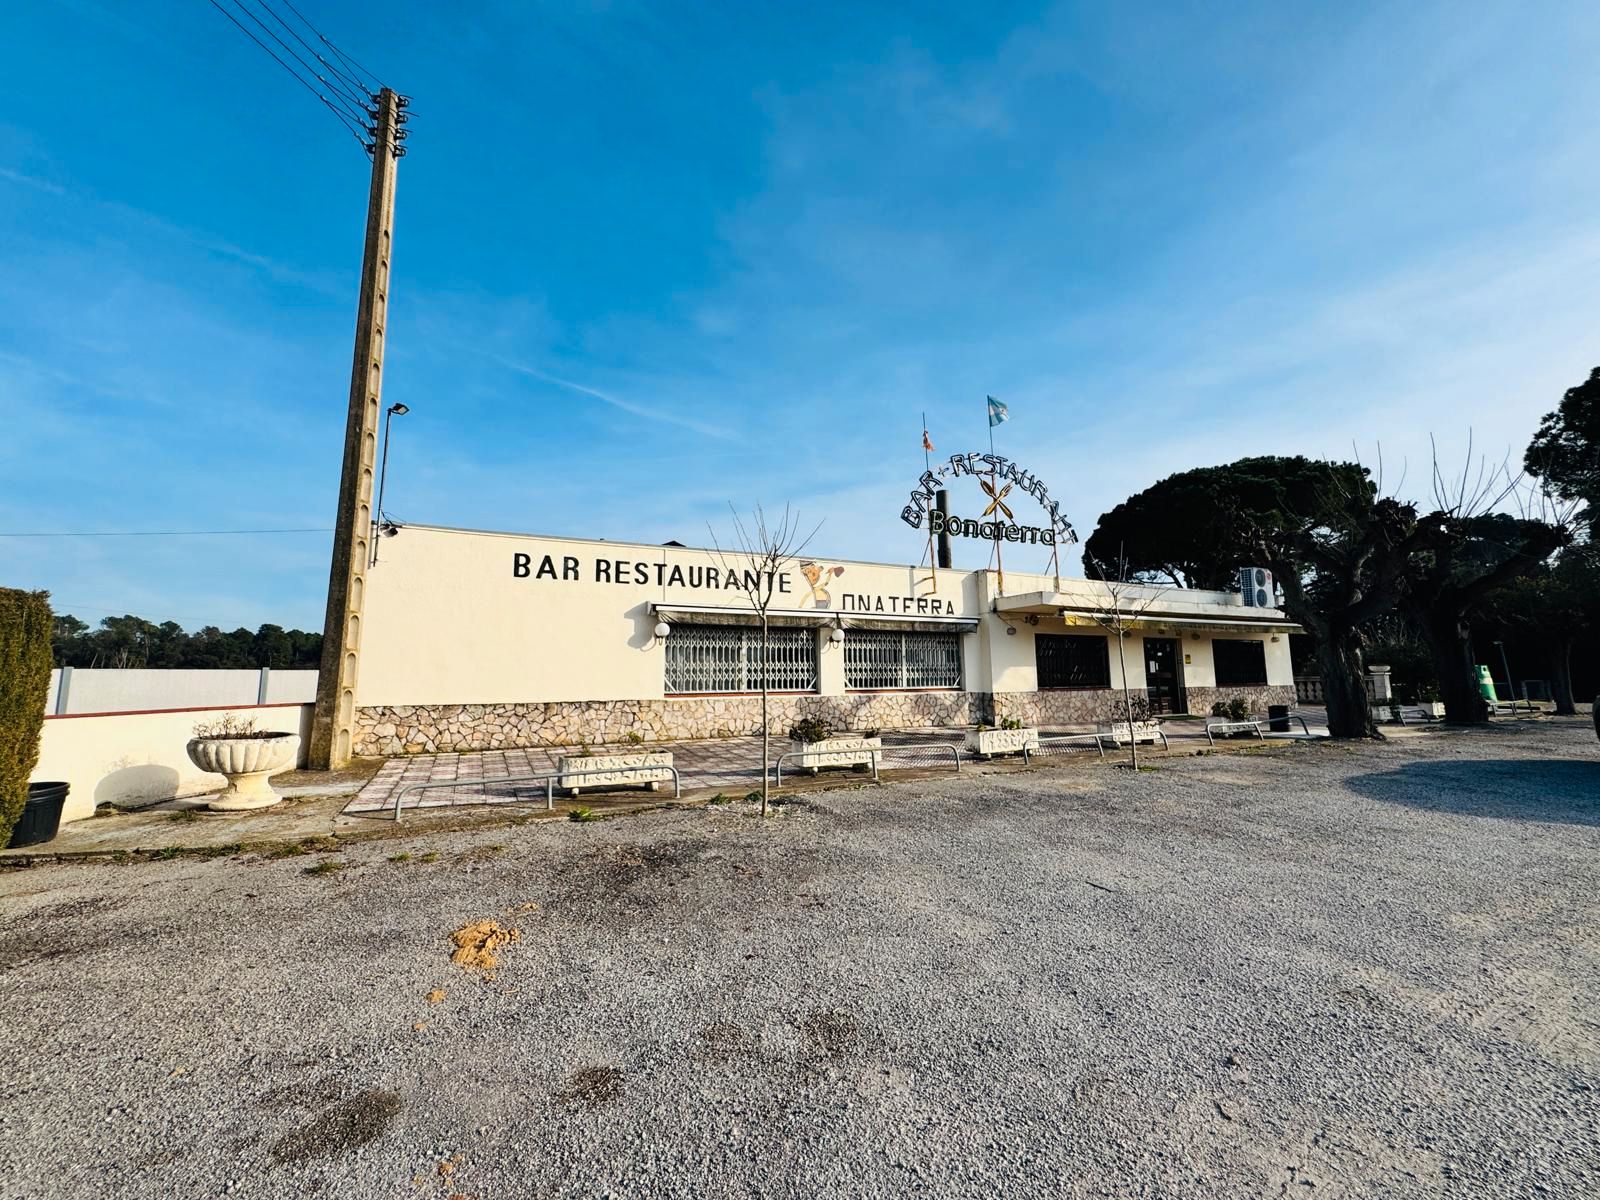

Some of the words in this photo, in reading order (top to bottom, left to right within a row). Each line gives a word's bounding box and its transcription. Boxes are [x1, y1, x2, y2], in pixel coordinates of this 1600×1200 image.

[901, 470, 943, 529] BAR
[930, 508, 1056, 545] Bonaterra
[513, 552, 580, 581] BAR
[595, 558, 792, 594] RESTAURANTE
